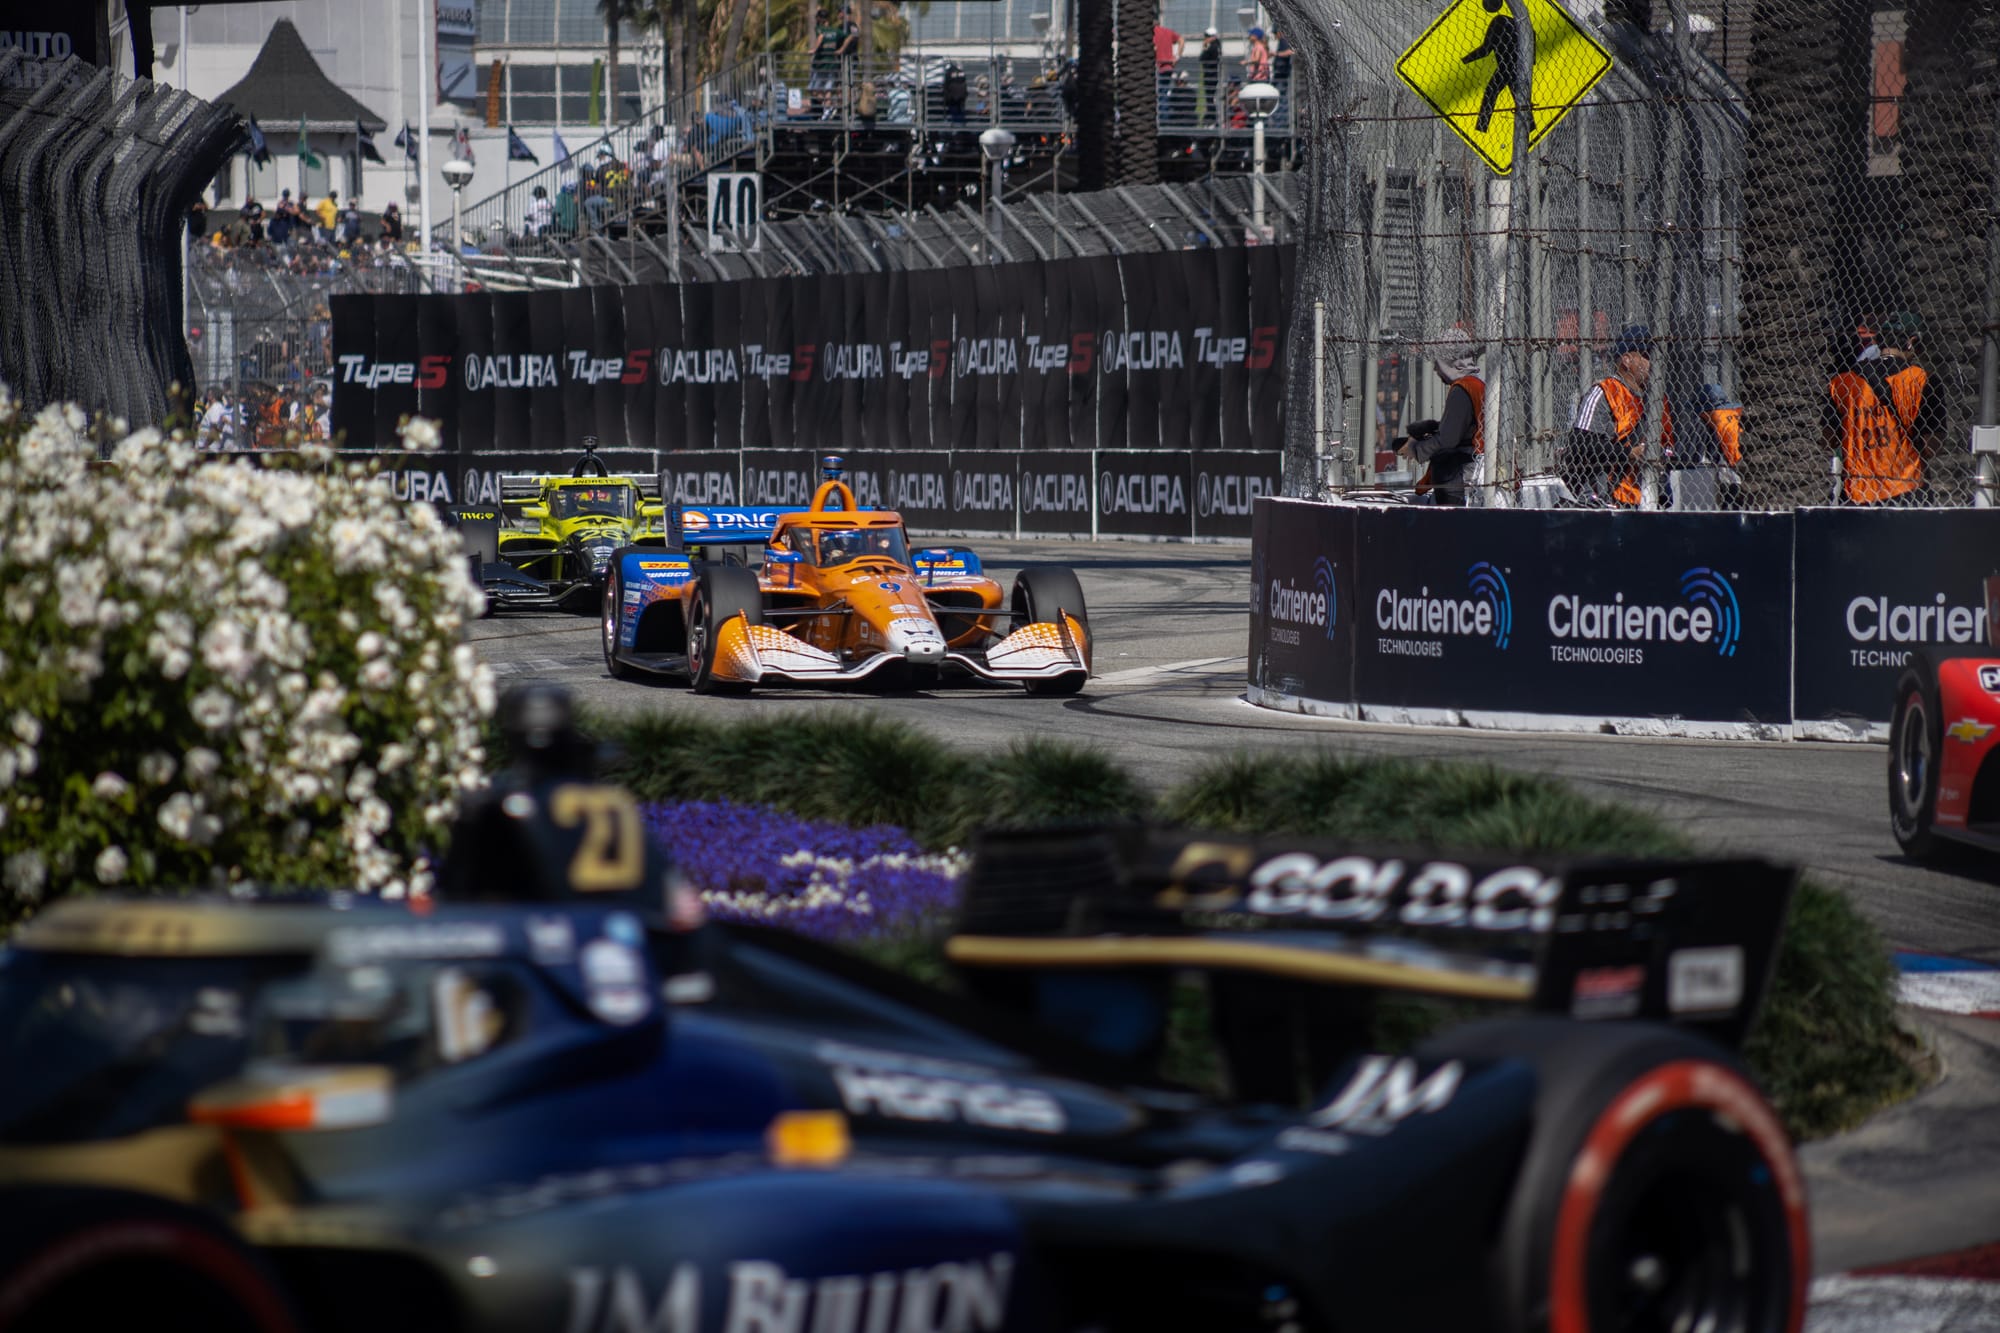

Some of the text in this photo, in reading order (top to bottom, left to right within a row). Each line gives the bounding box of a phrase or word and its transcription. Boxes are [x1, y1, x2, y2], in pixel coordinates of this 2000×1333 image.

[712, 176, 757, 249] 40
[746, 344, 816, 381] Type S
[833, 343, 884, 379] ACURA
[889, 340, 949, 379] Type S
[966, 338, 1018, 375] ACURA
[1026, 333, 1094, 376] Type S
[1114, 330, 1184, 371] ACURA
[1194, 326, 1278, 369] Type S
[338, 355, 452, 389] Type S
[480, 354, 558, 388] ACURA
[568, 349, 651, 384] Type S
[671, 349, 738, 383] ACURA
[375, 470, 453, 503] URA
[675, 472, 735, 504] ACURA
[757, 470, 810, 504] ACURA
[898, 473, 946, 509] ACURA
[962, 473, 1013, 510] ACURA
[1033, 474, 1088, 512] ACURA
[1114, 474, 1186, 514] ACURA
[1211, 475, 1275, 515] ACURA
[460, 512, 484, 520] TWG
[712, 512, 779, 529] PNC
[879, 582, 902, 594] 9
[1271, 577, 1326, 626] Clarience
[1376, 586, 1491, 635] Clarience
[1549, 592, 1713, 642] Clarience
[1378, 638, 1443, 657] TECHNOLOGIES
[1551, 645, 1644, 664] TECHNOLOGIES
